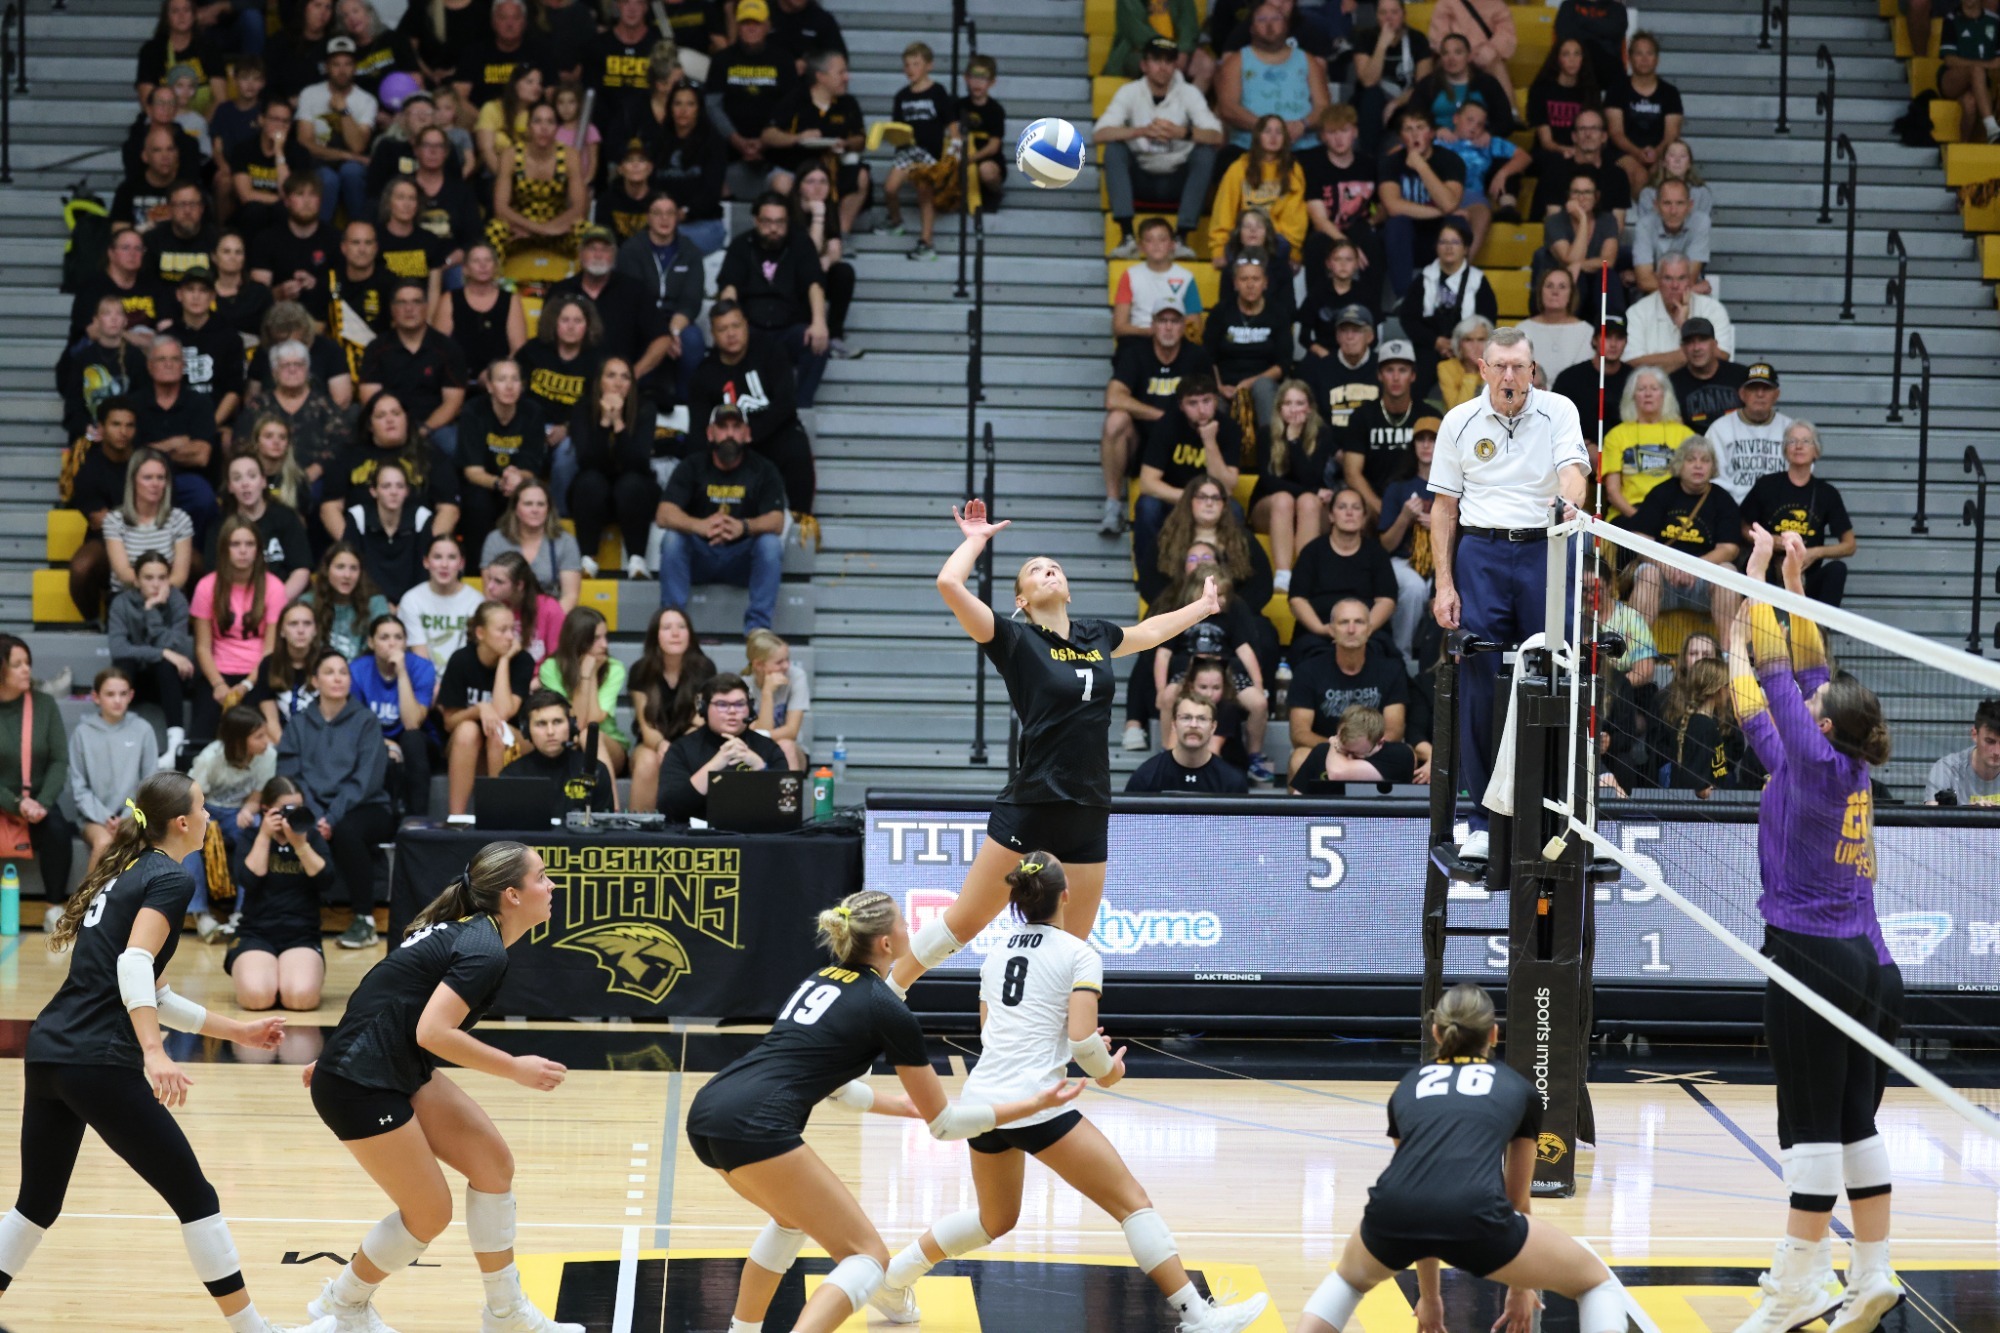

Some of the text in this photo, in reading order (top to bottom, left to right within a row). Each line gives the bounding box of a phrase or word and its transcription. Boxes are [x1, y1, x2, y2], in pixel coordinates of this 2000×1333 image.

[1370, 428, 1414, 444] TITAN
[421, 613, 468, 631] CKLE
[1050, 647, 1104, 662] OSHSH
[1075, 668, 1094, 702] 7
[877, 822, 988, 862] TIT
[1308, 825, 1345, 888] 5
[530, 846, 740, 874] W-OSHKOSH
[1007, 933, 1043, 949] UWO
[1092, 905, 1217, 949] hyme
[1487, 936, 1509, 968] S
[1642, 931, 1671, 971] 1
[818, 966, 860, 984] UWO
[1001, 956, 1028, 1007] 8
[1194, 973, 1262, 982] DAKTRONICS
[778, 980, 842, 1026] 19
[1533, 987, 1552, 1042] sports
[1415, 1064, 1497, 1100] 26
